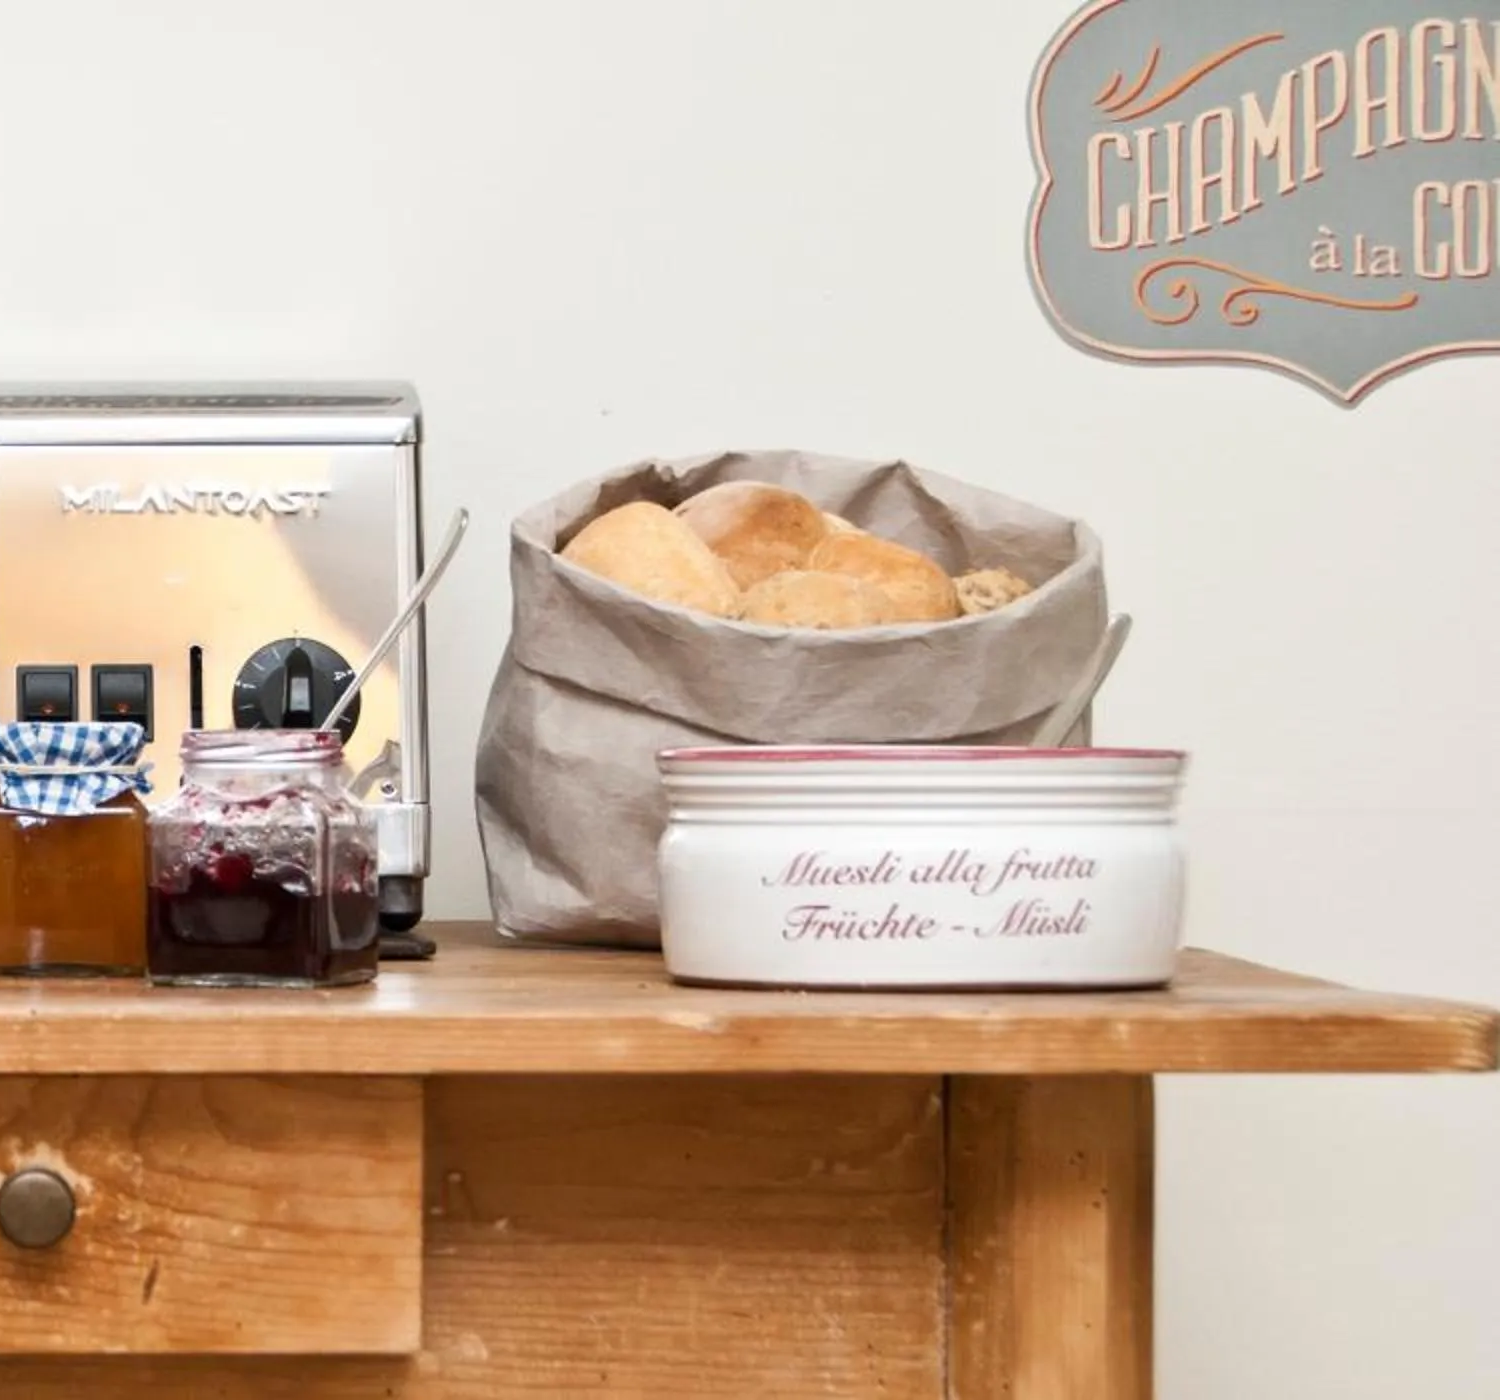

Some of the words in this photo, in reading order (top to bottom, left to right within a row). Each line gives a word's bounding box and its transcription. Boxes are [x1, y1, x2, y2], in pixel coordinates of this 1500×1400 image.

[1087, 17, 1500, 251] CHAMPAGN
[1309, 225, 1342, 272] à
[1353, 234, 1402, 277] la
[1413, 178, 1500, 280] CO
[59, 484, 332, 519] MILANTOAST
[761, 850, 901, 887] Muesli
[909, 848, 986, 885] alla
[970, 848, 1097, 896] frutta
[781, 903, 936, 942] Früchte
[973, 898, 1092, 938] Müsli
